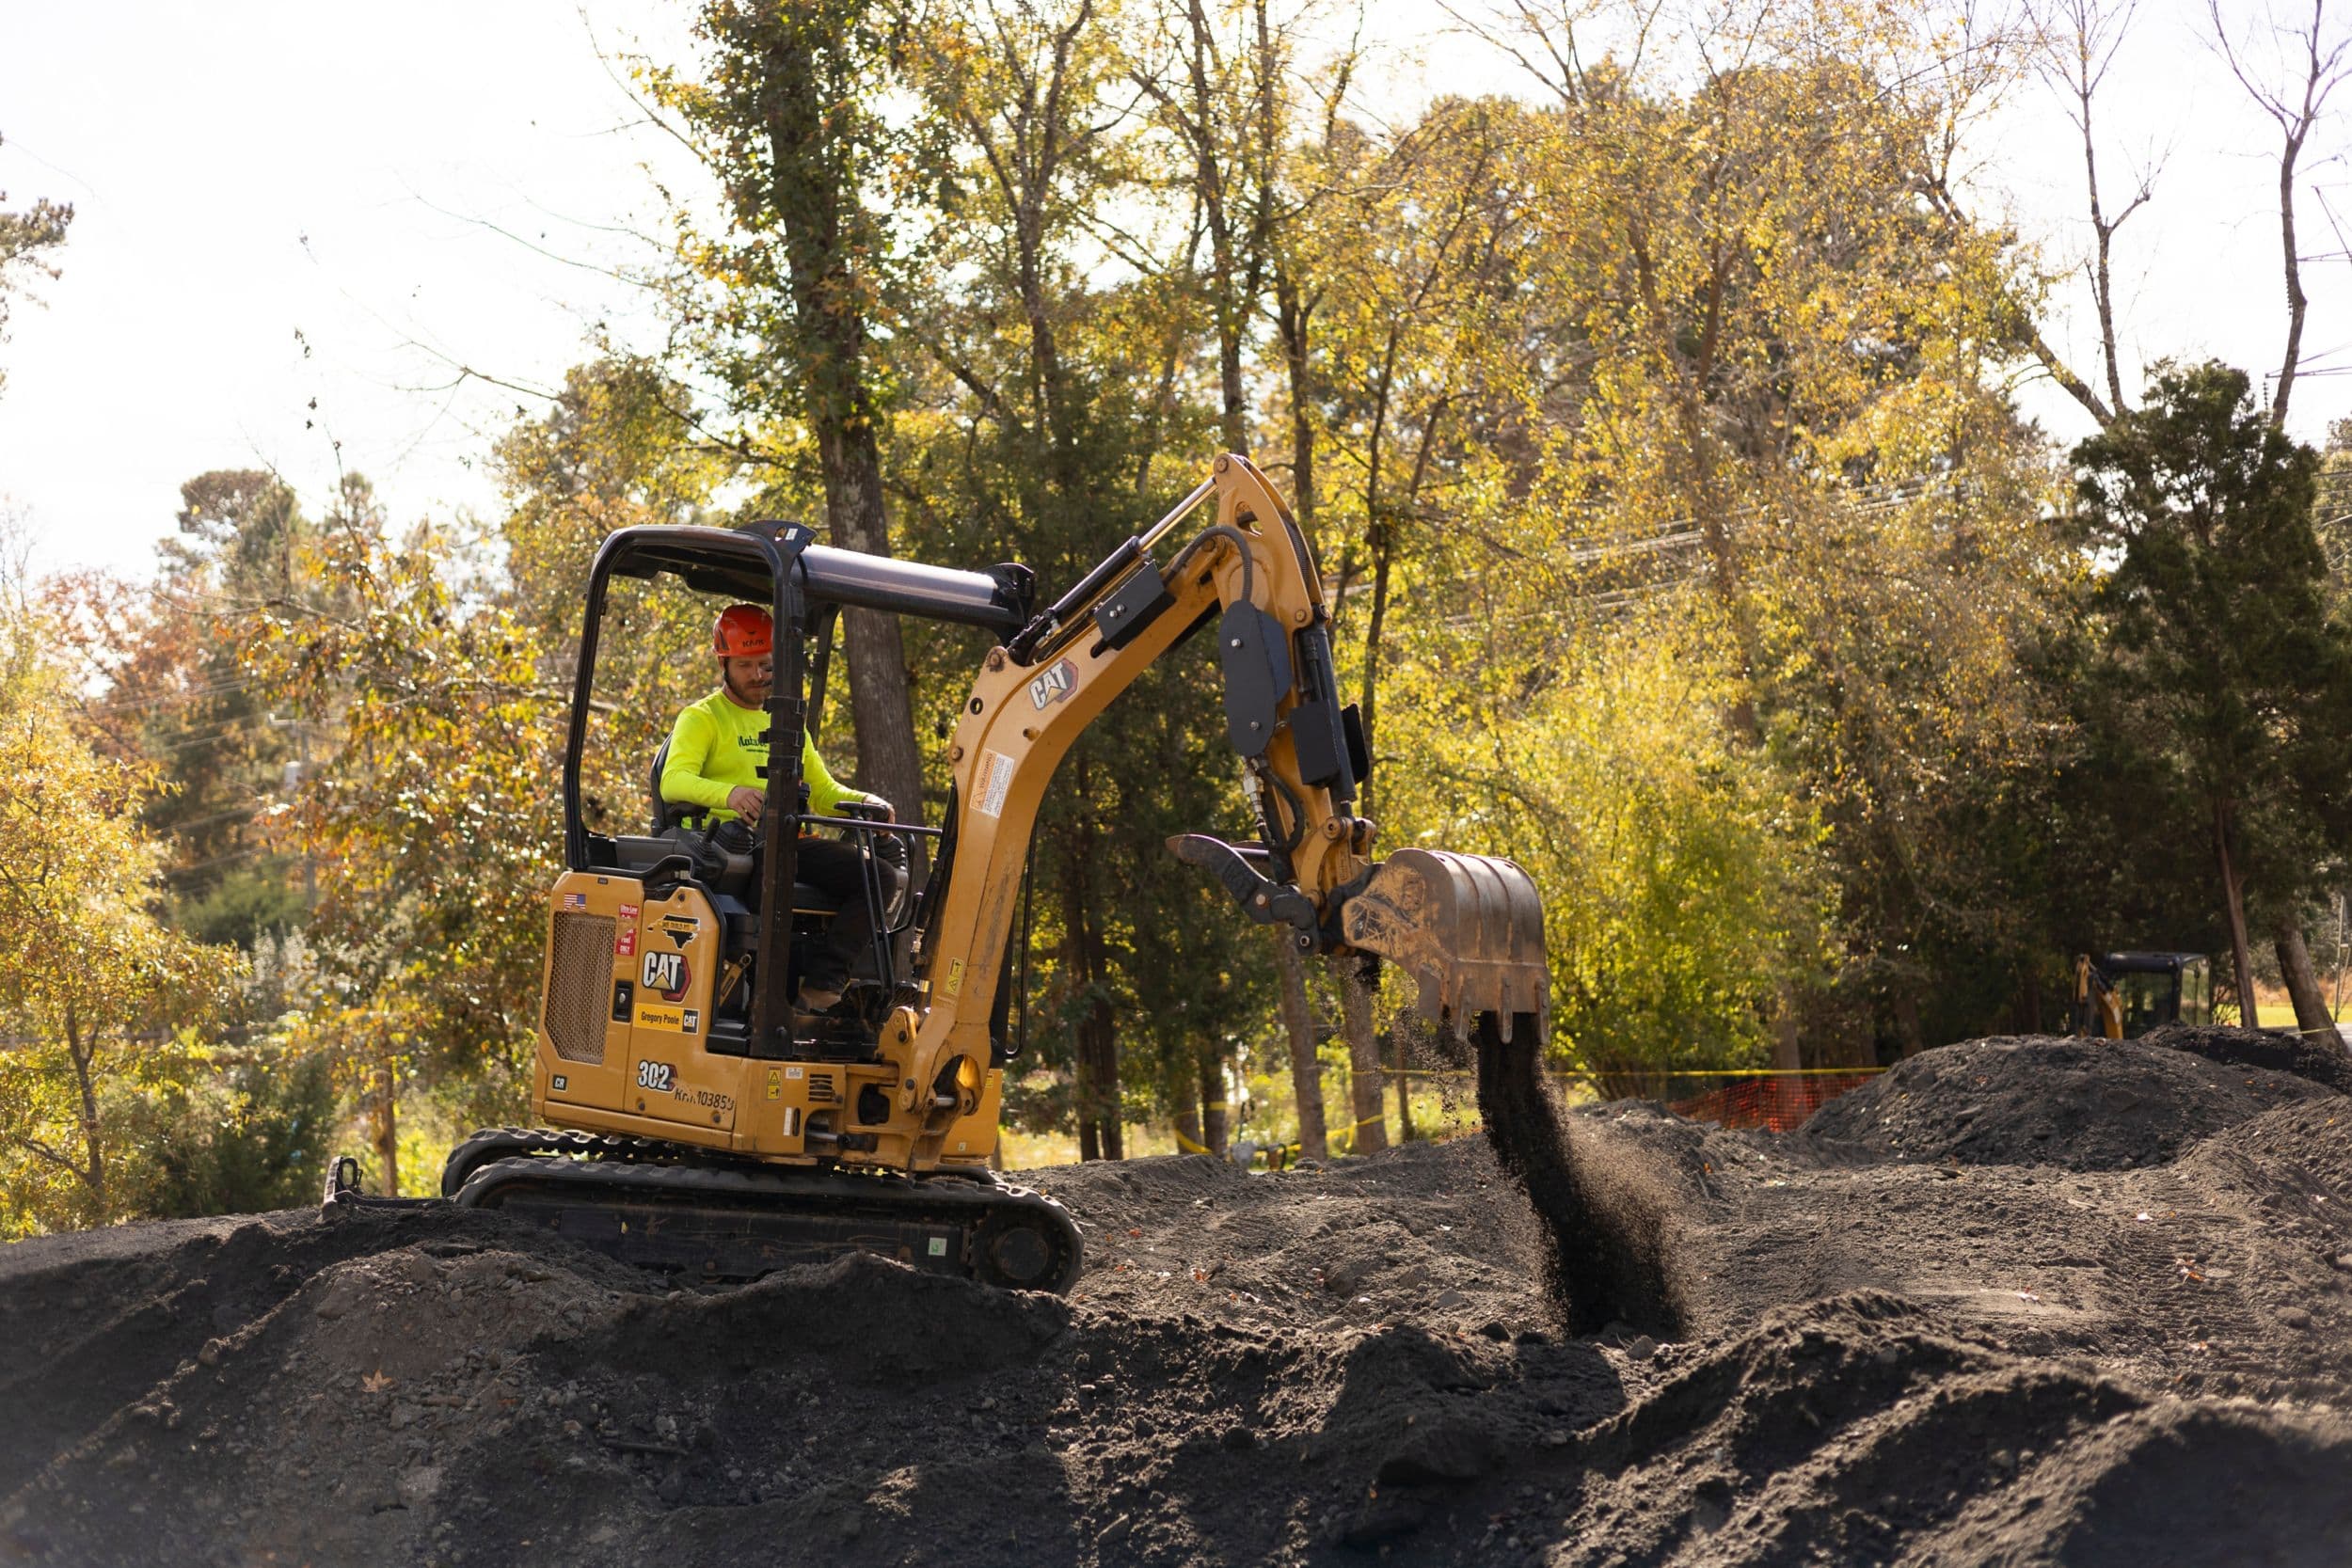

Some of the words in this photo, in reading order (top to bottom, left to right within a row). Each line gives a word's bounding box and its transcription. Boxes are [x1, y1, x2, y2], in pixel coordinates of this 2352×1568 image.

[1030, 662, 1068, 709] CAT
[643, 952, 681, 990] CAT
[641, 1011, 662, 1024] Gregory
[663, 1014, 679, 1024] Poole
[683, 1015, 696, 1027] CAT
[638, 1060, 671, 1089] 302
